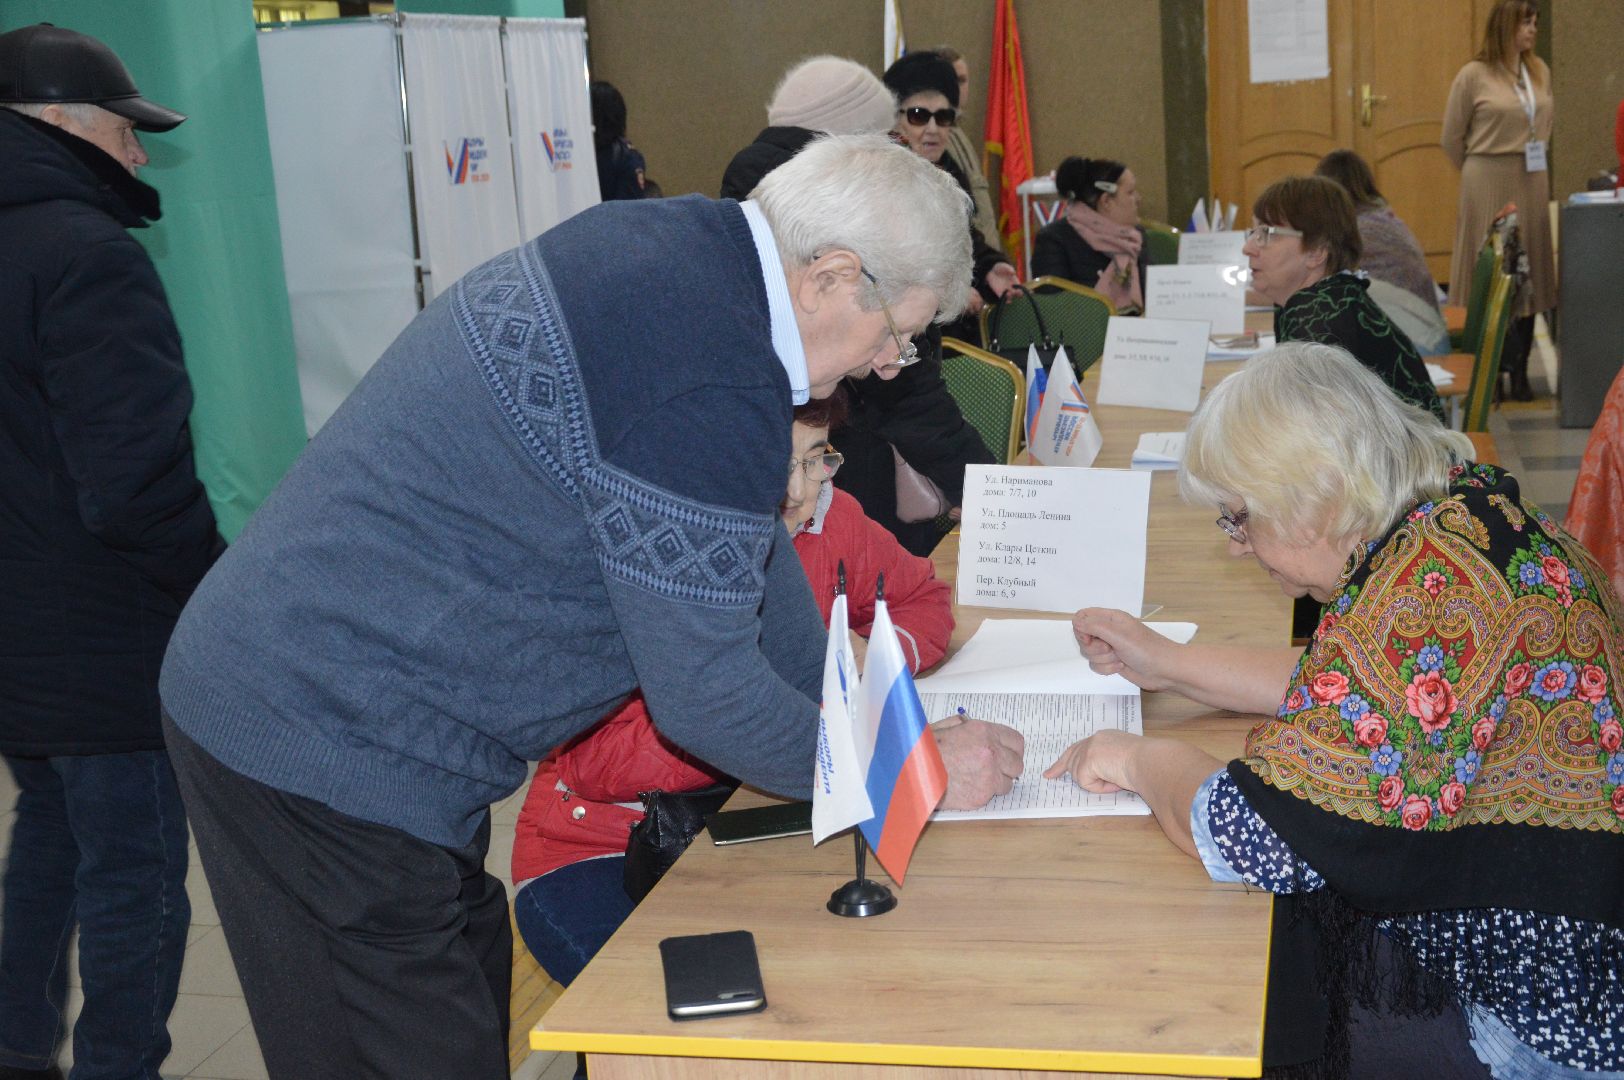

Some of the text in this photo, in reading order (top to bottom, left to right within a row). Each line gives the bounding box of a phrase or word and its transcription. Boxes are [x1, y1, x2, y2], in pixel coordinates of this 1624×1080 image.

[1001, 475, 1053, 486] Нариманова
[1009, 488, 1024, 498] 7/7,
[1026, 489, 1037, 498] 10
[981, 508, 1071, 521] Ул. Площадь Ленина
[980, 521, 1007, 530] дом: 5
[979, 541, 1057, 555] Ул. Клары Цеткин
[1003, 555, 1023, 566] 12/8,
[1026, 556, 1037, 566] 14
[976, 574, 1037, 588] Пер. Клубный
[1000, 589, 1009, 599] 6,
[1010, 590, 1017, 598] 9
